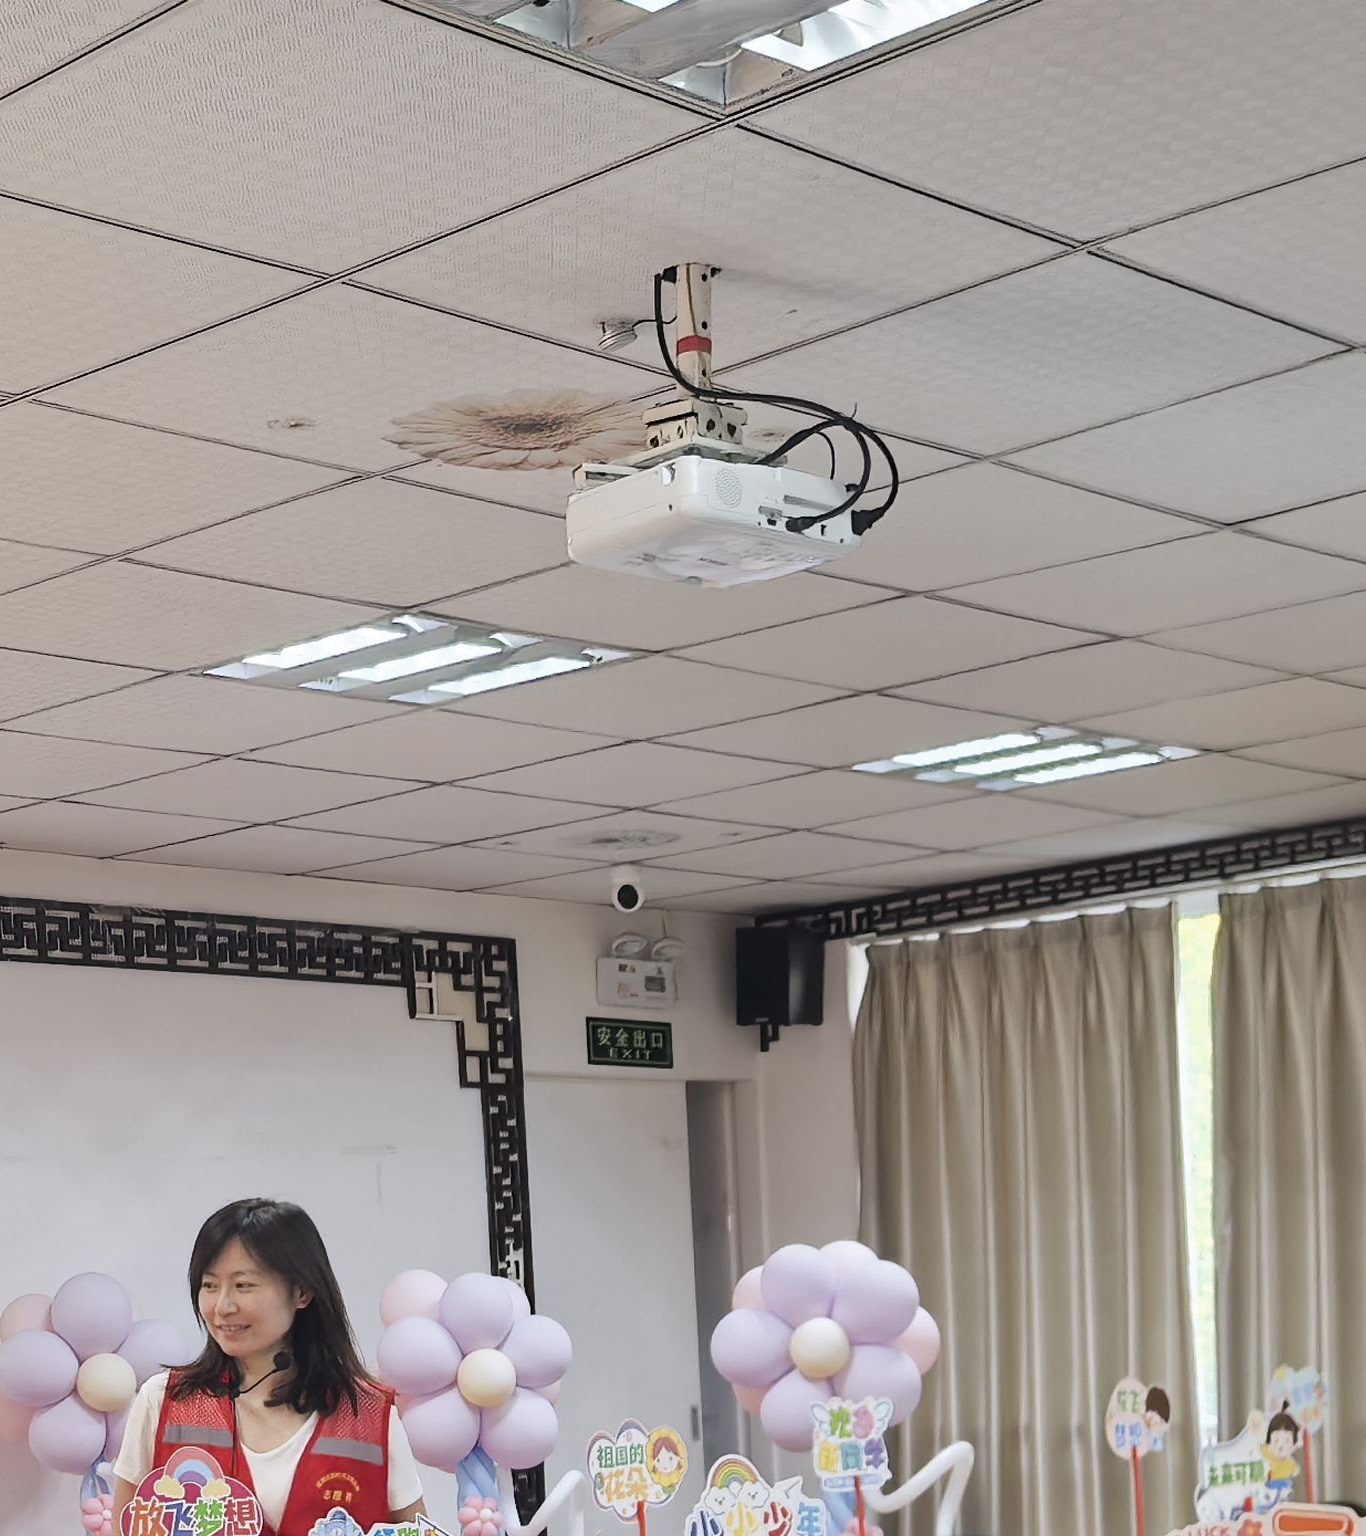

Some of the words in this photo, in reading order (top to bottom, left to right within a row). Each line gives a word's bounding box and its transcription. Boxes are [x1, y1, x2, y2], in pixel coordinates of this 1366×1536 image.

[597, 1027, 663, 1049] 安全出口
[609, 1048, 651, 1061] EXIT
[596, 1443, 644, 1468] 祖国的
